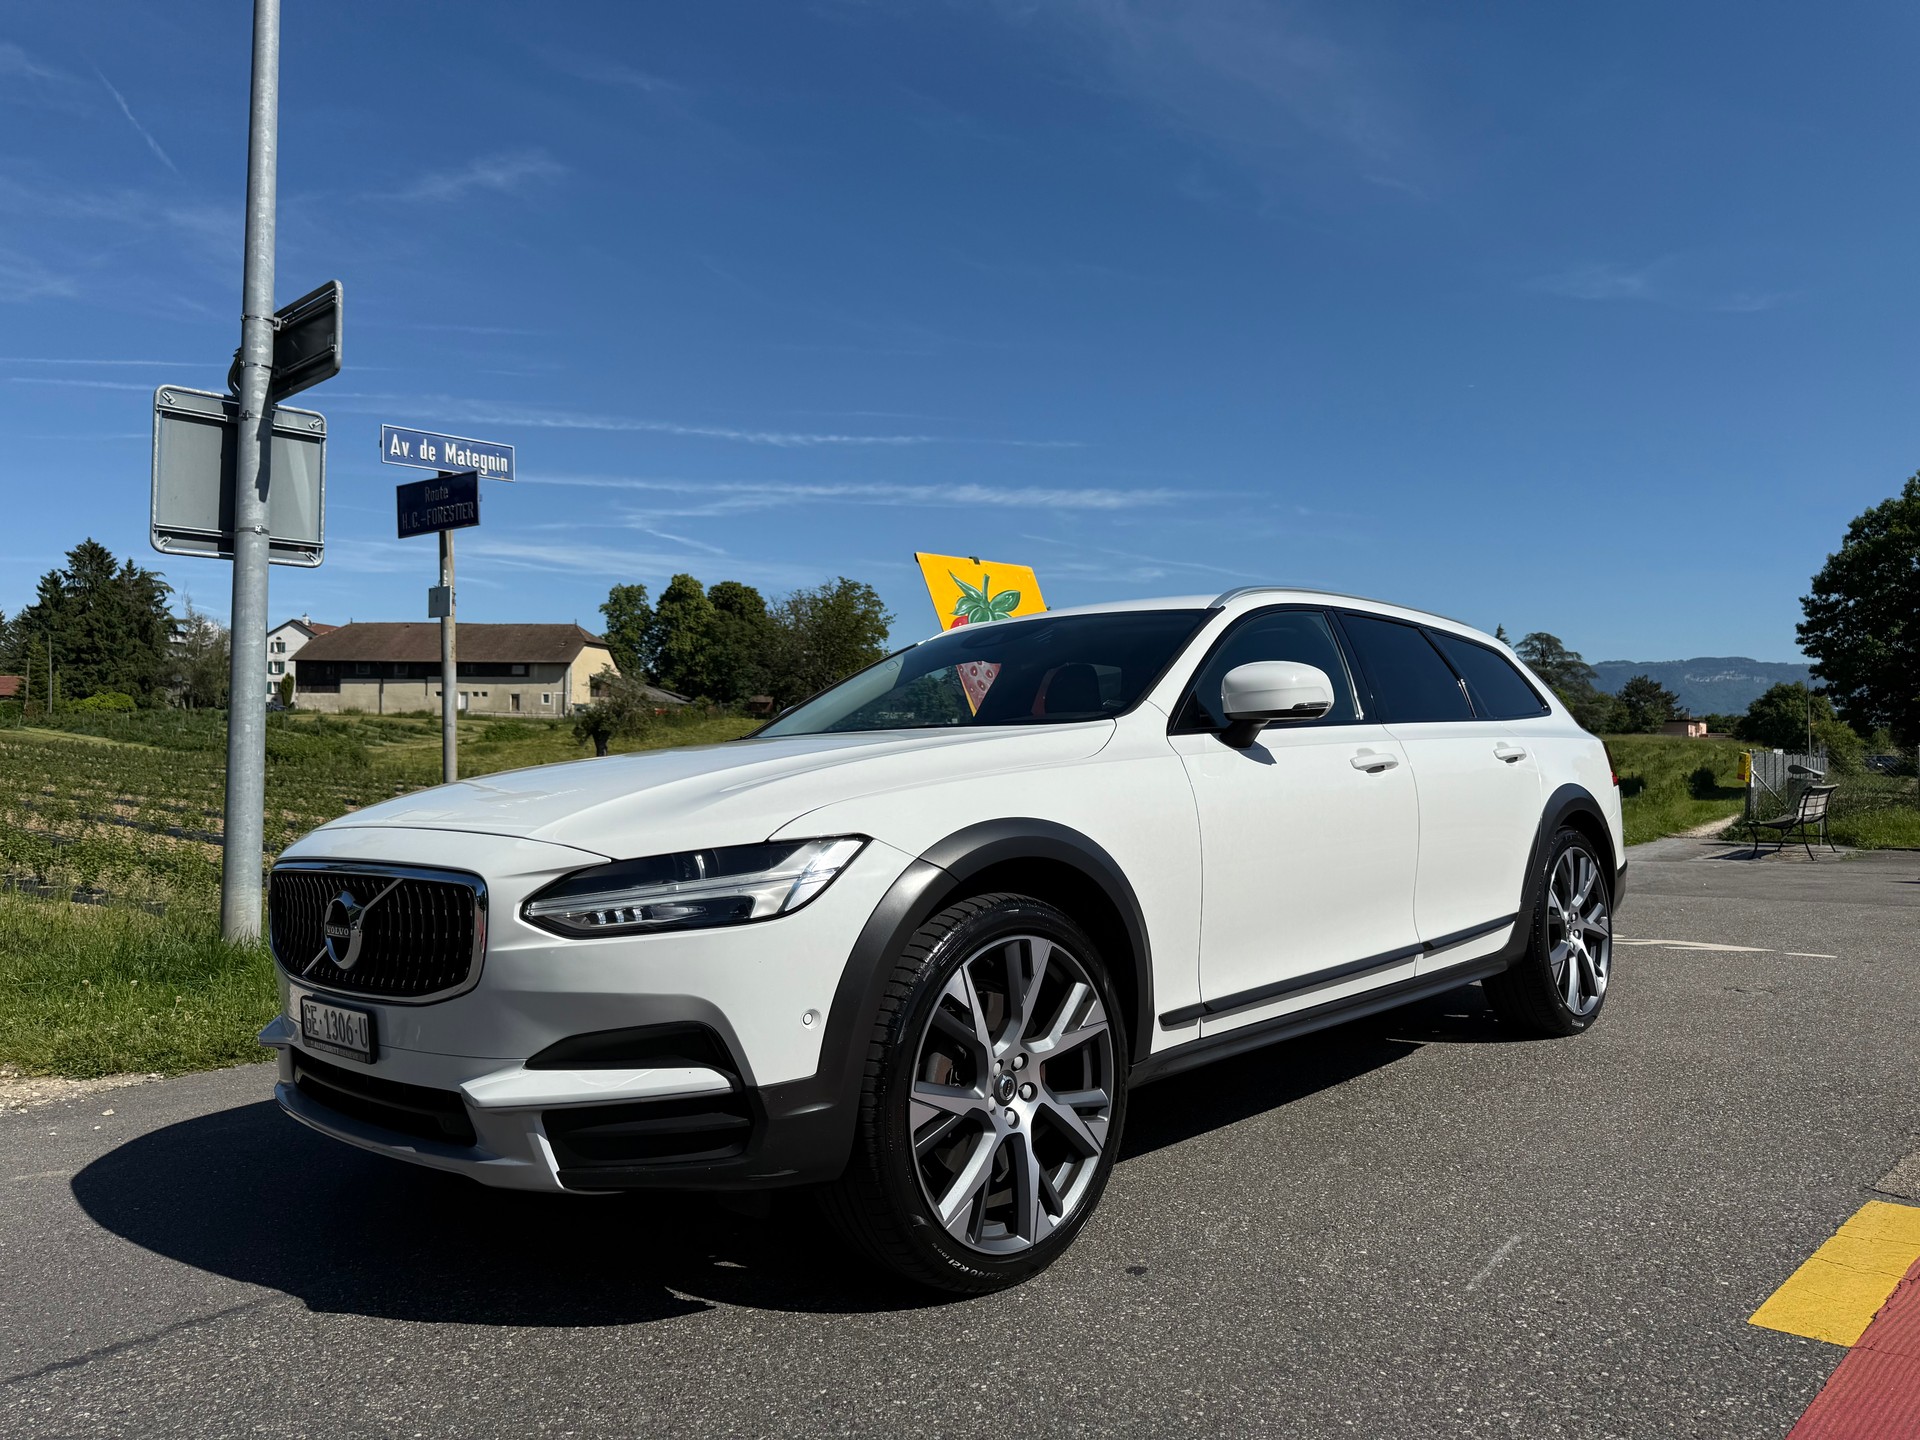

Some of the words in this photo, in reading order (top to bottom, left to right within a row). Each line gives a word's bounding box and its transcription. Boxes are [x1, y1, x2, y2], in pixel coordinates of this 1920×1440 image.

[390, 434, 414, 458] Av.
[419, 439, 436, 462] de
[445, 442, 508, 475] Mategnin
[425, 485, 449, 503] Route
[326, 924, 350, 936] VOLVO
